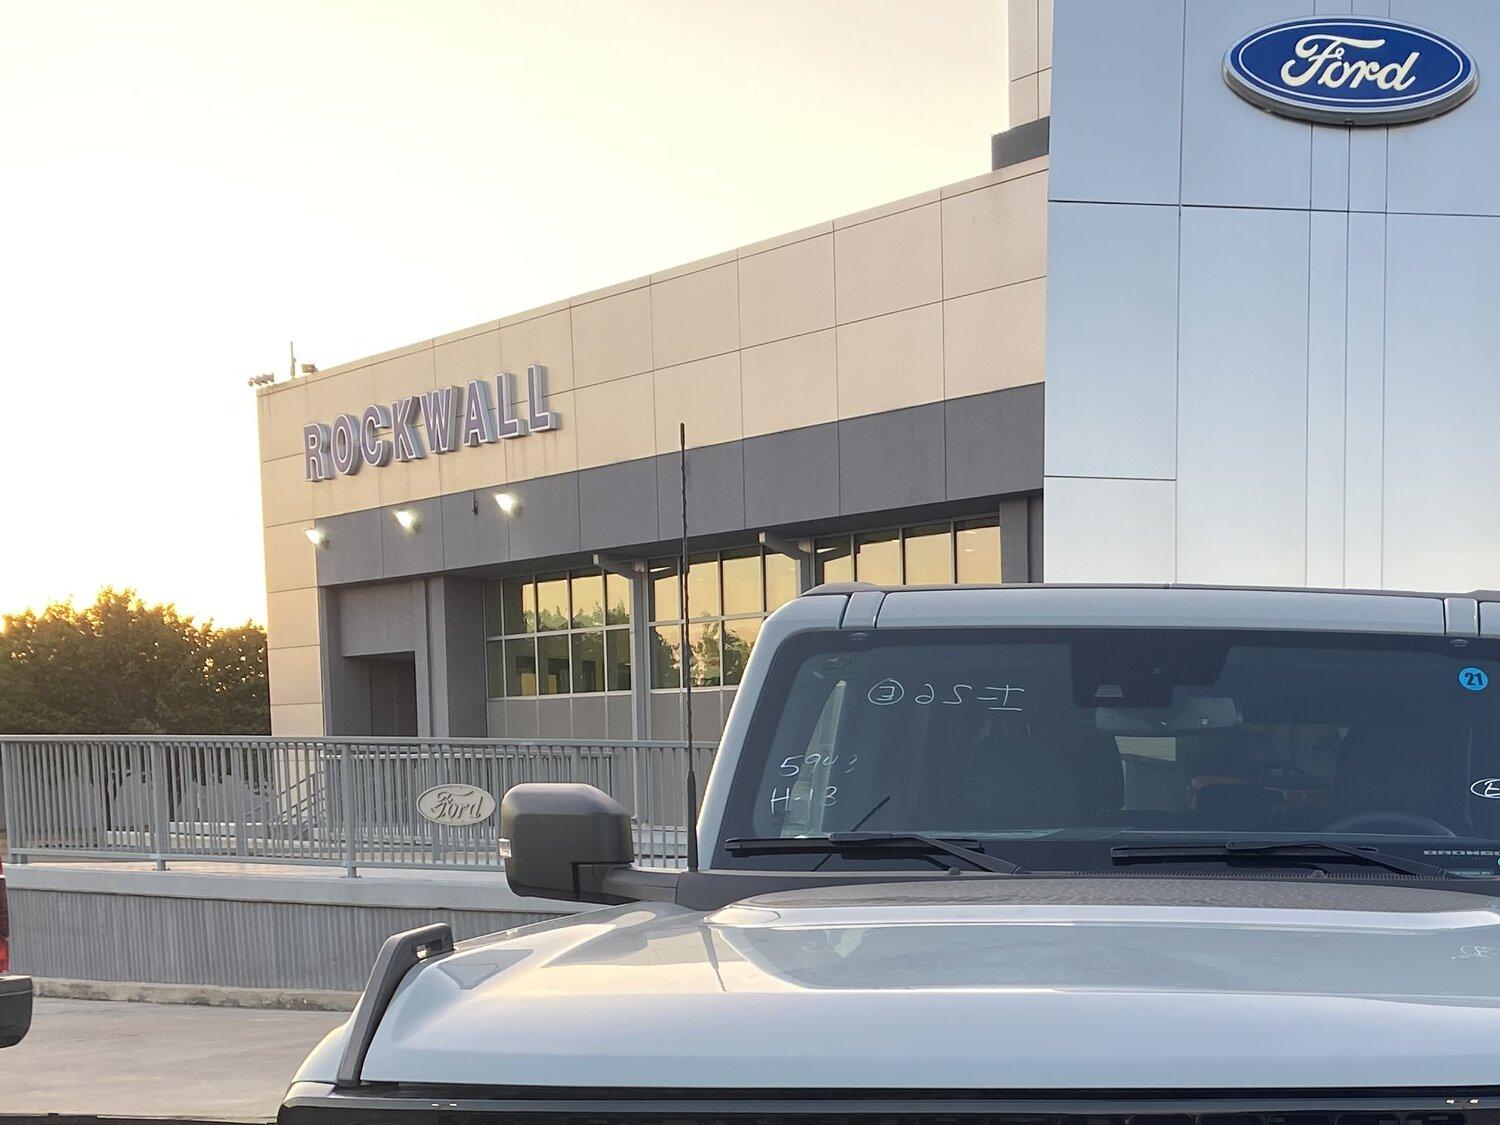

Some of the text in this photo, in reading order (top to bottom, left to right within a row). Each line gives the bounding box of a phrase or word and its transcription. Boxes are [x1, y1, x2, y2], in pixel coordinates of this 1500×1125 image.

[1281, 34, 1420, 91] Ford
[304, 363, 560, 483] ROCKWALL
[1464, 672, 1484, 686] 21
[431, 790, 484, 819] Ford
